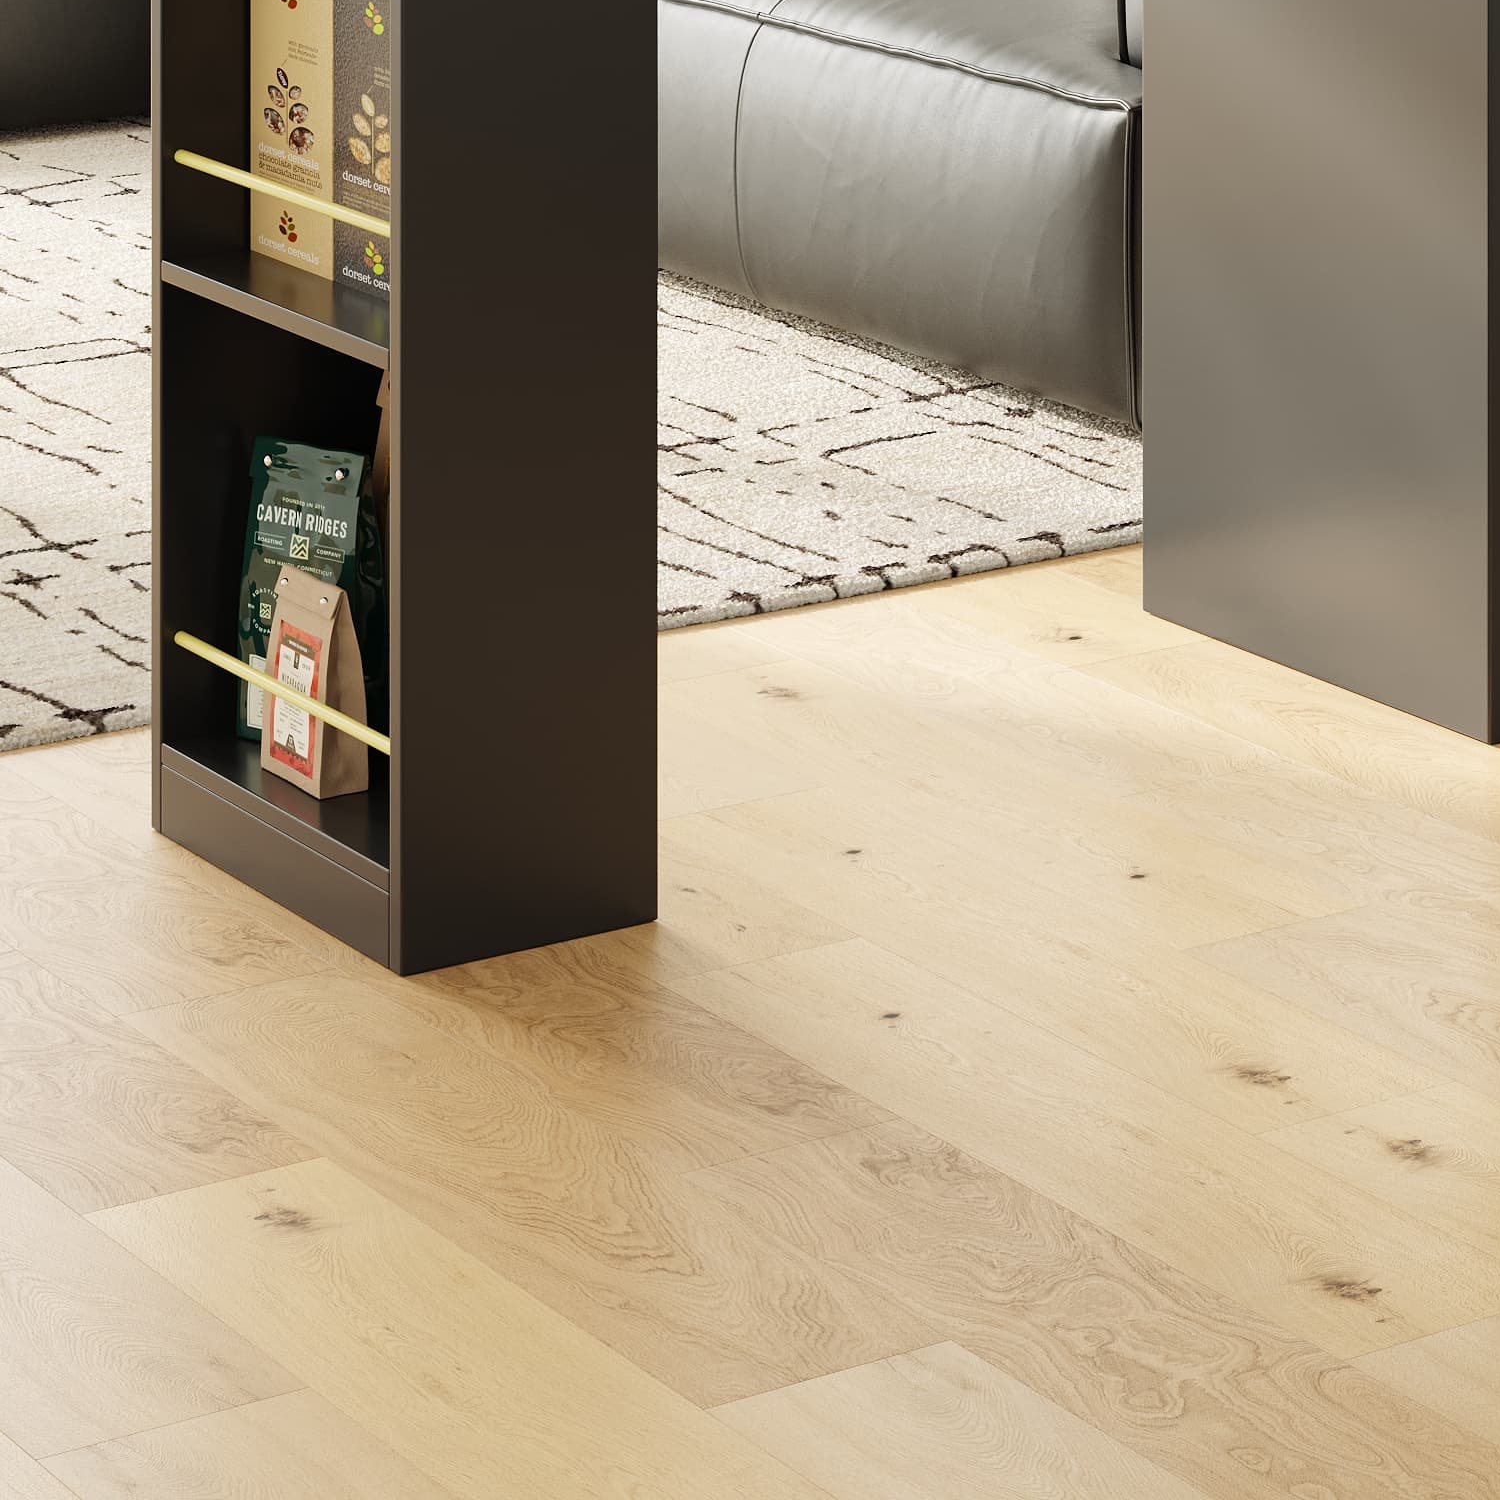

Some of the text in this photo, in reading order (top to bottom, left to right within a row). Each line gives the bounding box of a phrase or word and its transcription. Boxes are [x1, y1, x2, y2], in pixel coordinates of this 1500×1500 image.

[258, 152, 321, 180] chocolate granola
[342, 170, 372, 190] dorset
[342, 265, 372, 285] dorset
[256, 503, 348, 539] CAVERN RIDGES
[263, 557, 276, 565] NEW
[315, 548, 342, 559] COMPANY
